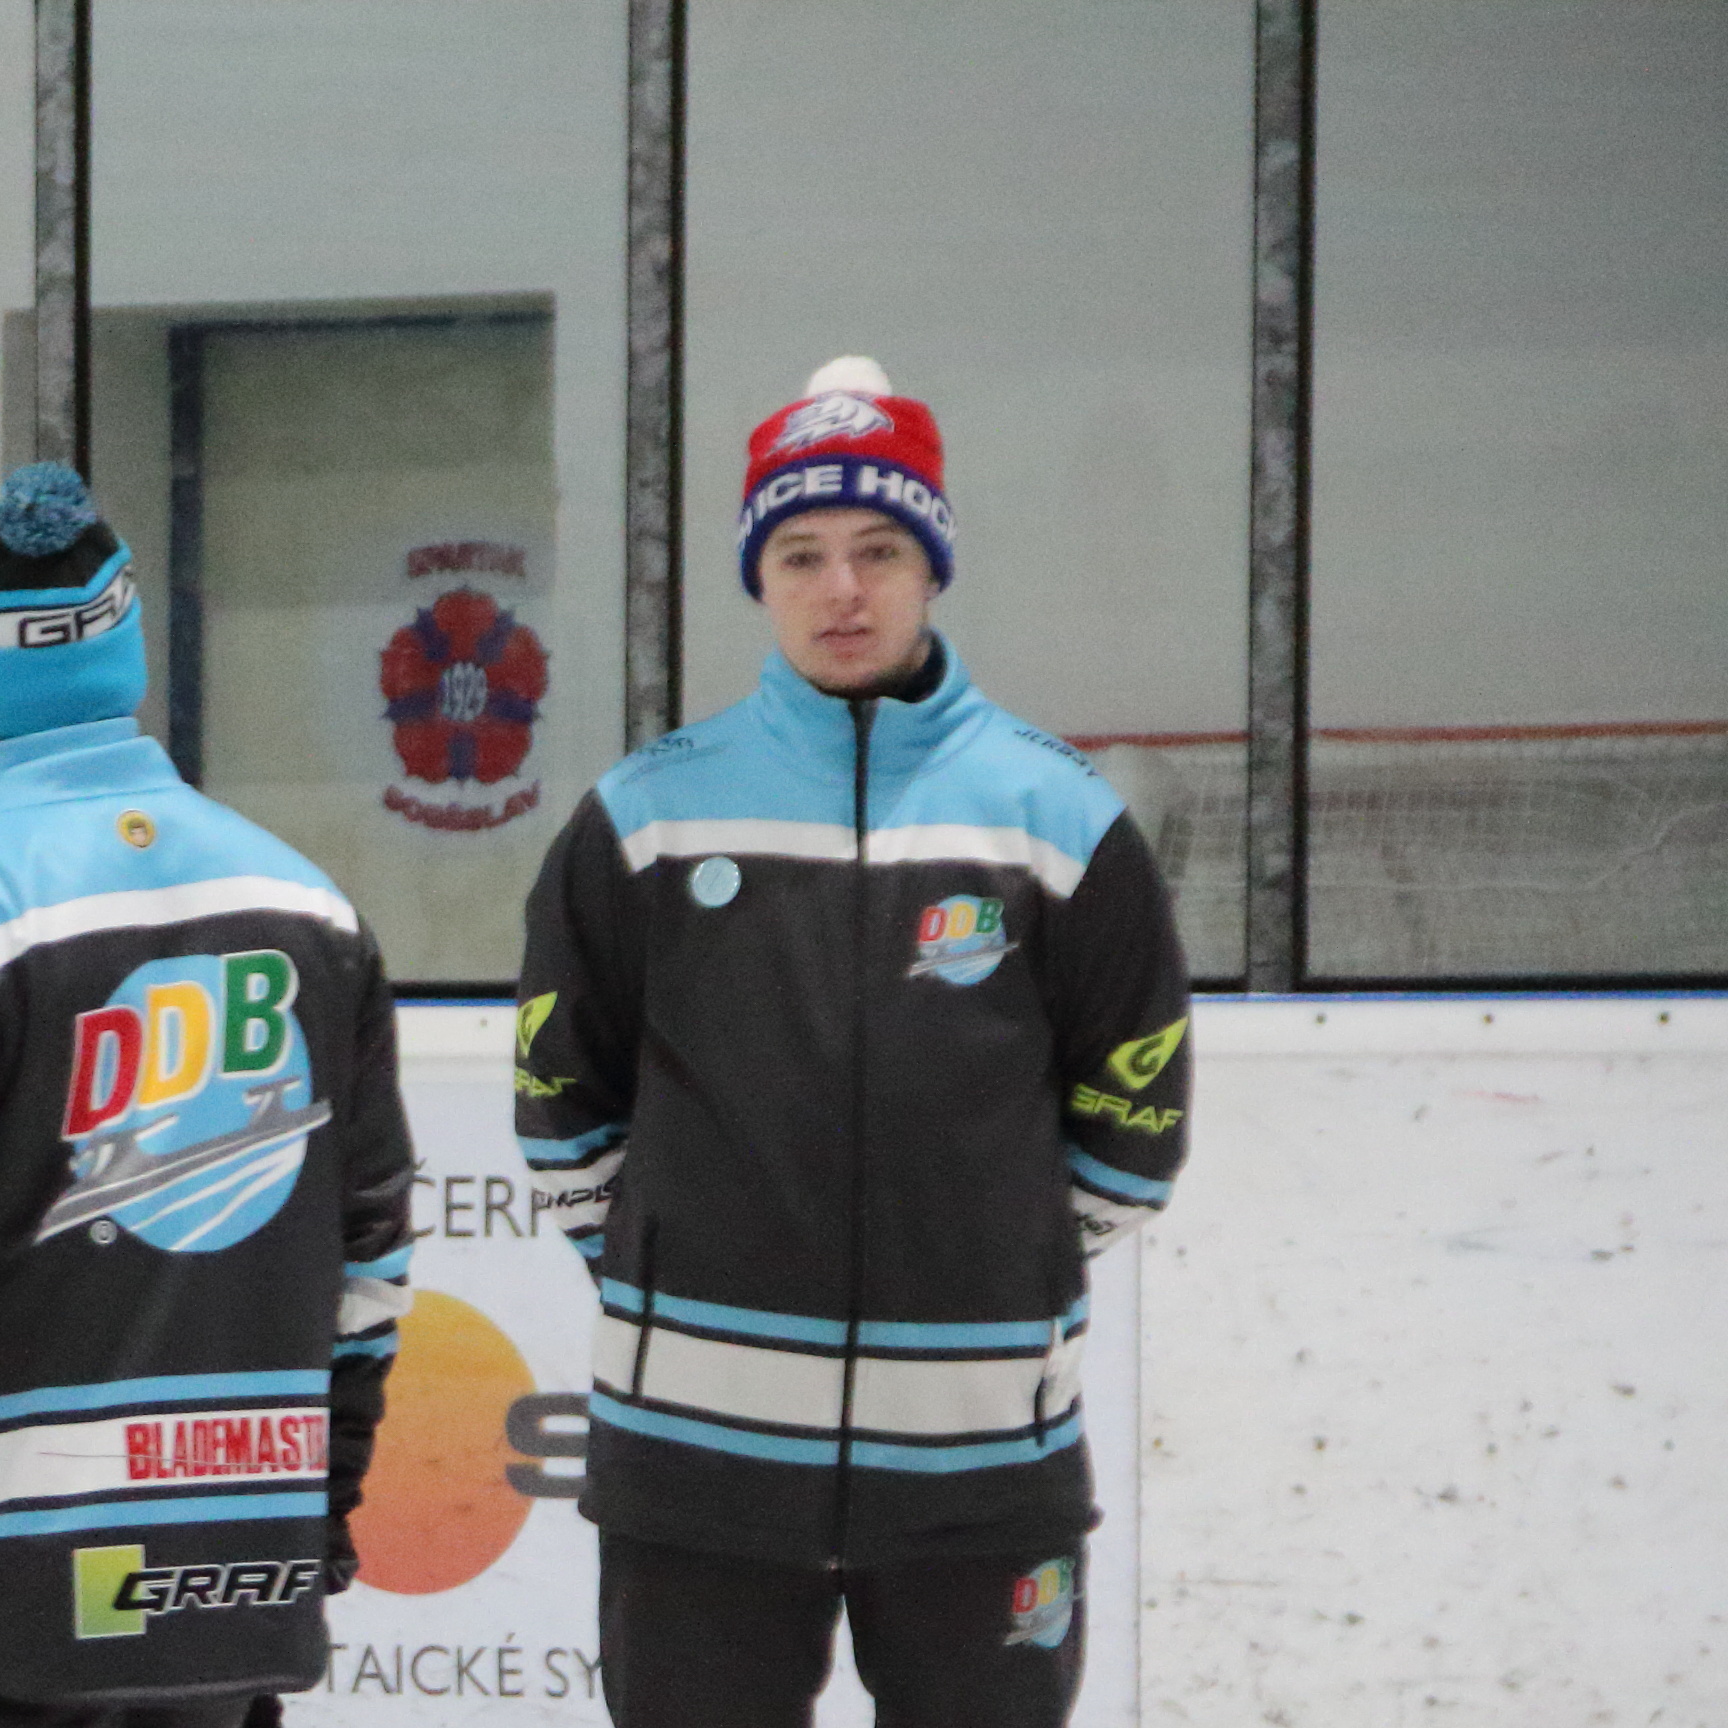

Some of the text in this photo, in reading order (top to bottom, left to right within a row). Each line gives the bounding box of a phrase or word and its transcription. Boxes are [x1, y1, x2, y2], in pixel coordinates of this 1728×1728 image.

[755, 465, 842, 521] ICE
[920, 898, 1003, 943] DDB
[61, 948, 299, 1142] DDB
[505, 1392, 591, 1499] S
[112, 1559, 321, 1616] GRAF
[327, 1632, 601, 1700] TAICKÉ SY
